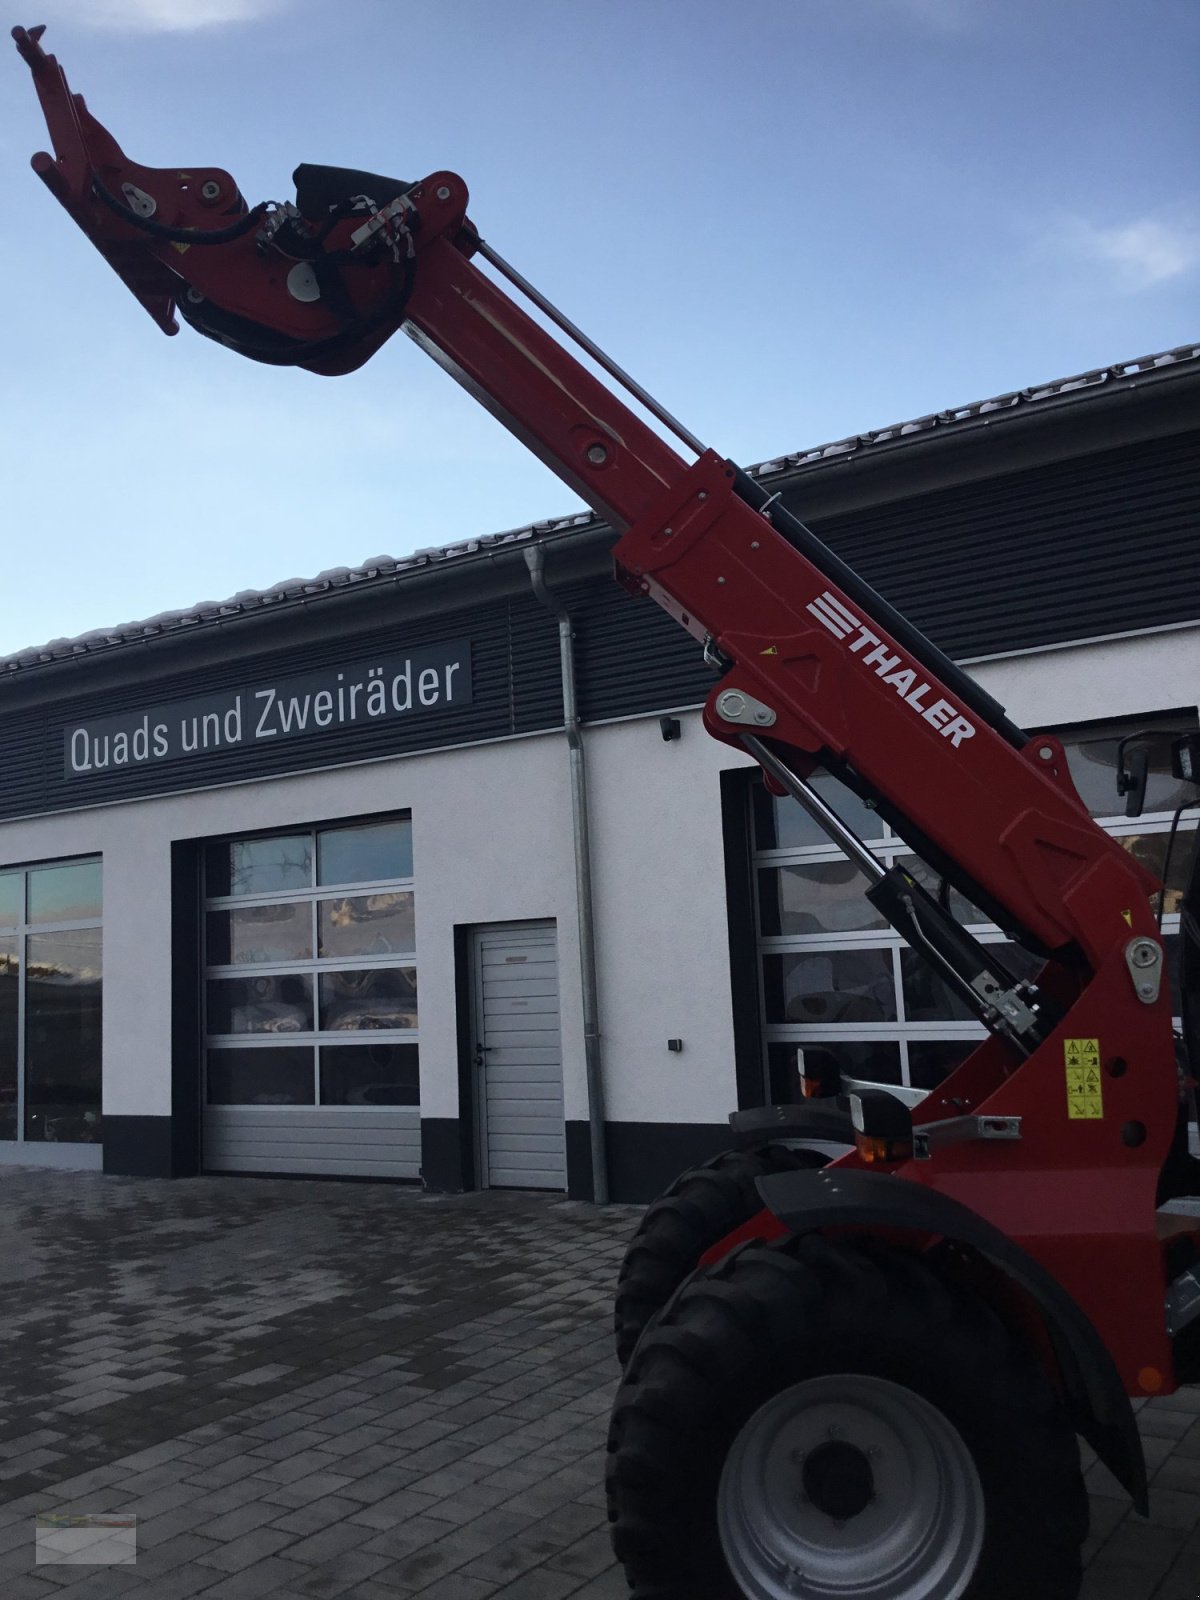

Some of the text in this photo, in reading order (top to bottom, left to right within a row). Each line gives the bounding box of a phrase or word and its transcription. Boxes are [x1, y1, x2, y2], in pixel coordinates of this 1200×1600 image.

[71, 660, 460, 771] Quads und Zweiräder
[848, 625, 976, 748] THALER
